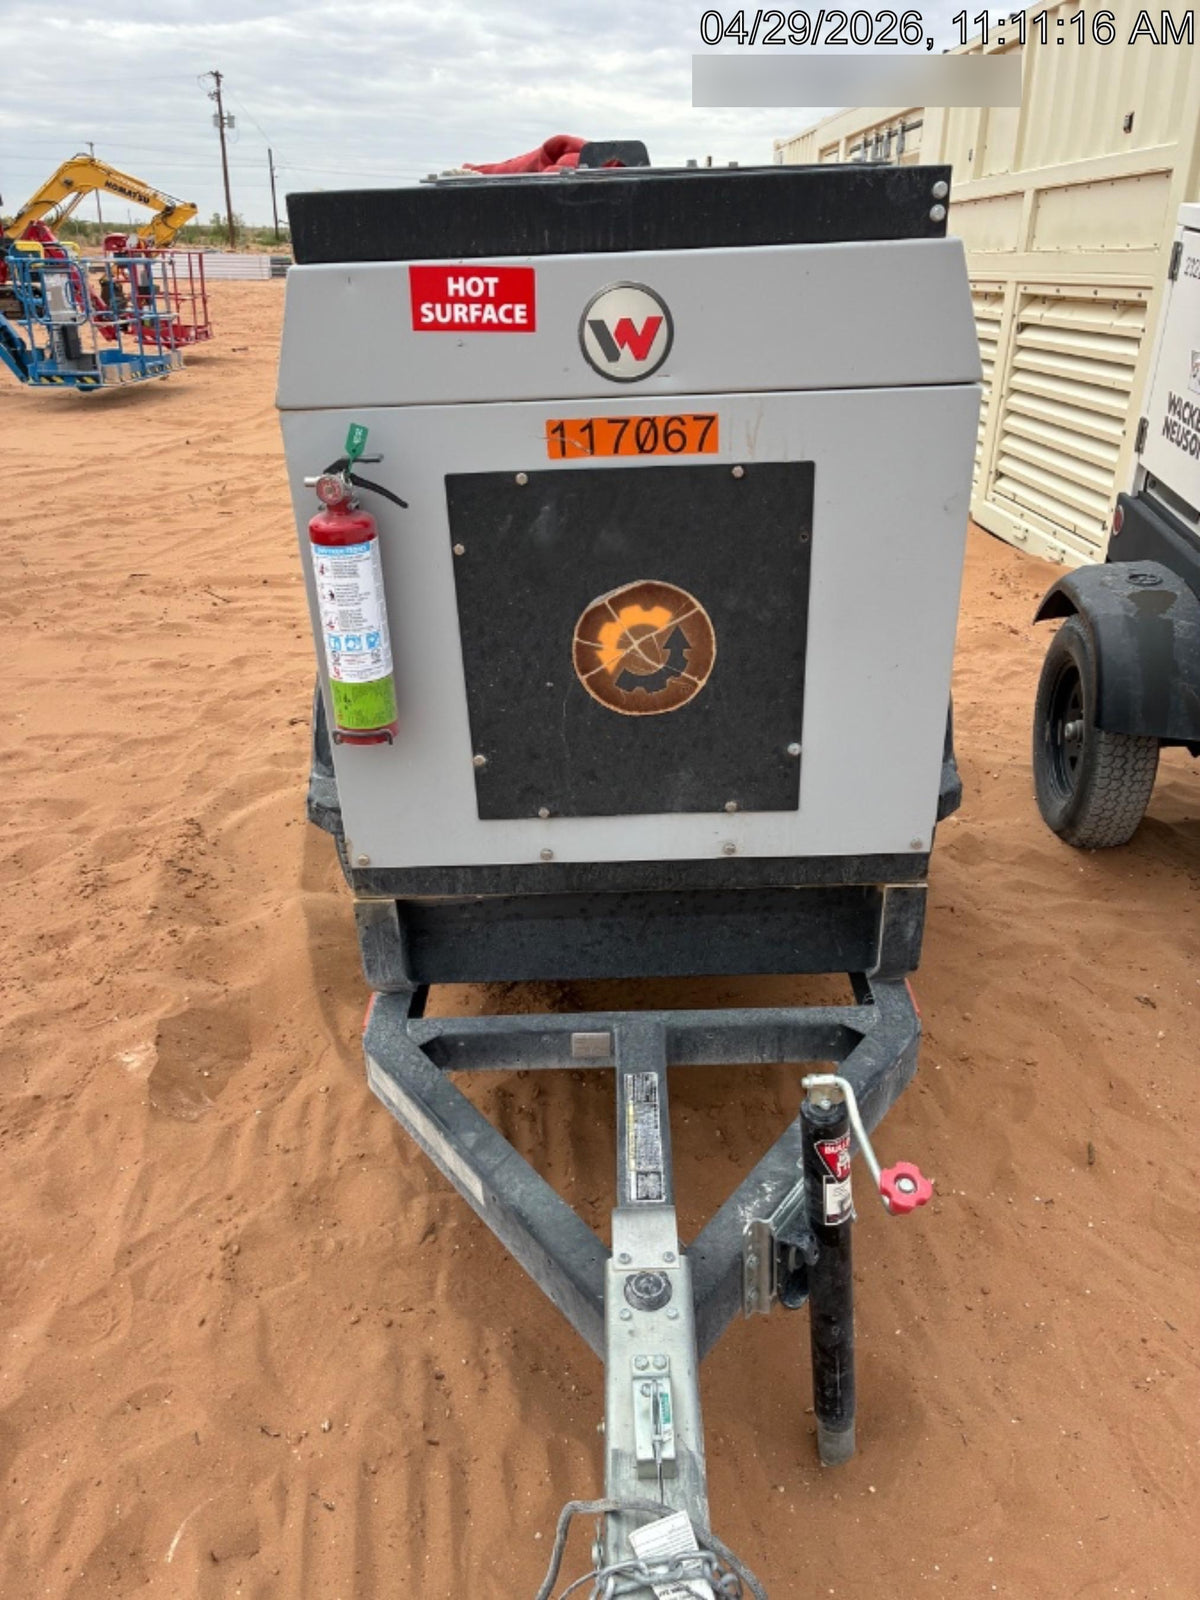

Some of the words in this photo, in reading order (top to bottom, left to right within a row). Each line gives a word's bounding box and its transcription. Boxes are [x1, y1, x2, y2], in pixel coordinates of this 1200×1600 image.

[104, 180, 150, 204] KOMATSU
[447, 276, 499, 298] HOT
[420, 303, 527, 324] SURFACE
[551, 414, 717, 457] 117067
